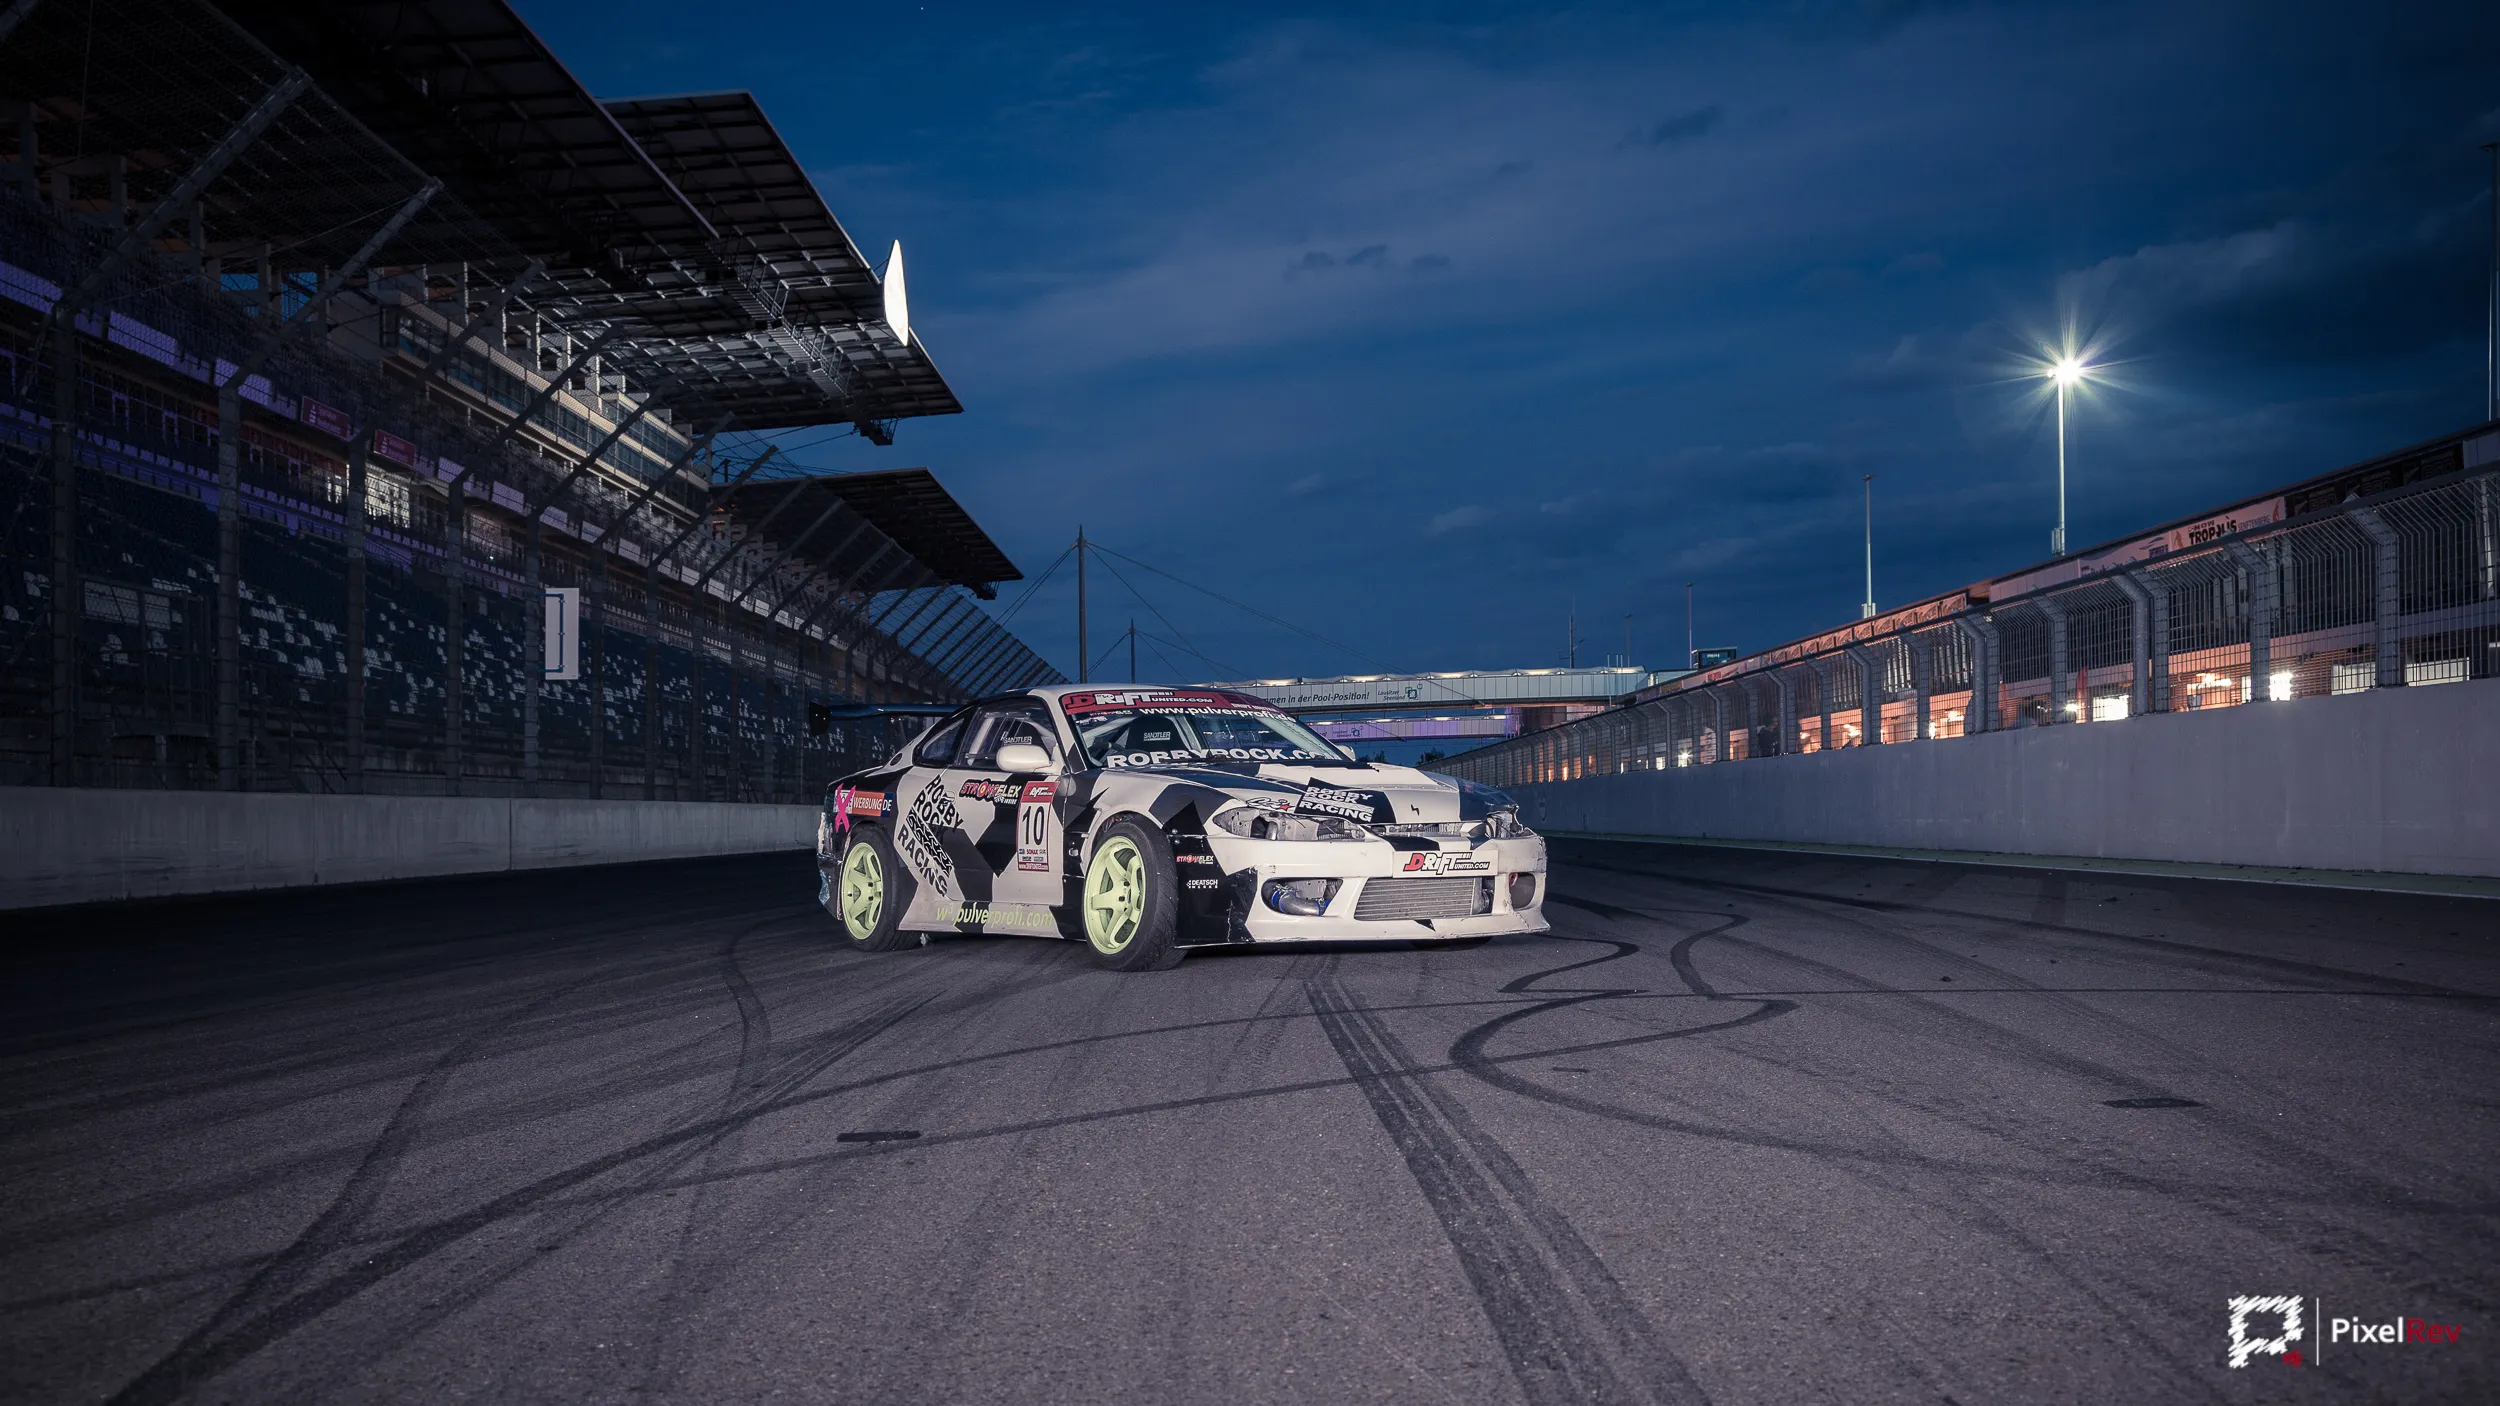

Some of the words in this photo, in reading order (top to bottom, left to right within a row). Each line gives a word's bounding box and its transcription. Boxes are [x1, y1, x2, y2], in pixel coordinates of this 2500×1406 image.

[1288, 695, 1296, 703] in
[1298, 694, 1311, 703] der
[1312, 691, 1370, 702] Pool-Position!
[1021, 805, 1045, 846] 10
[1298, 800, 1373, 823] RACING
[897, 823, 948, 898] RACING
